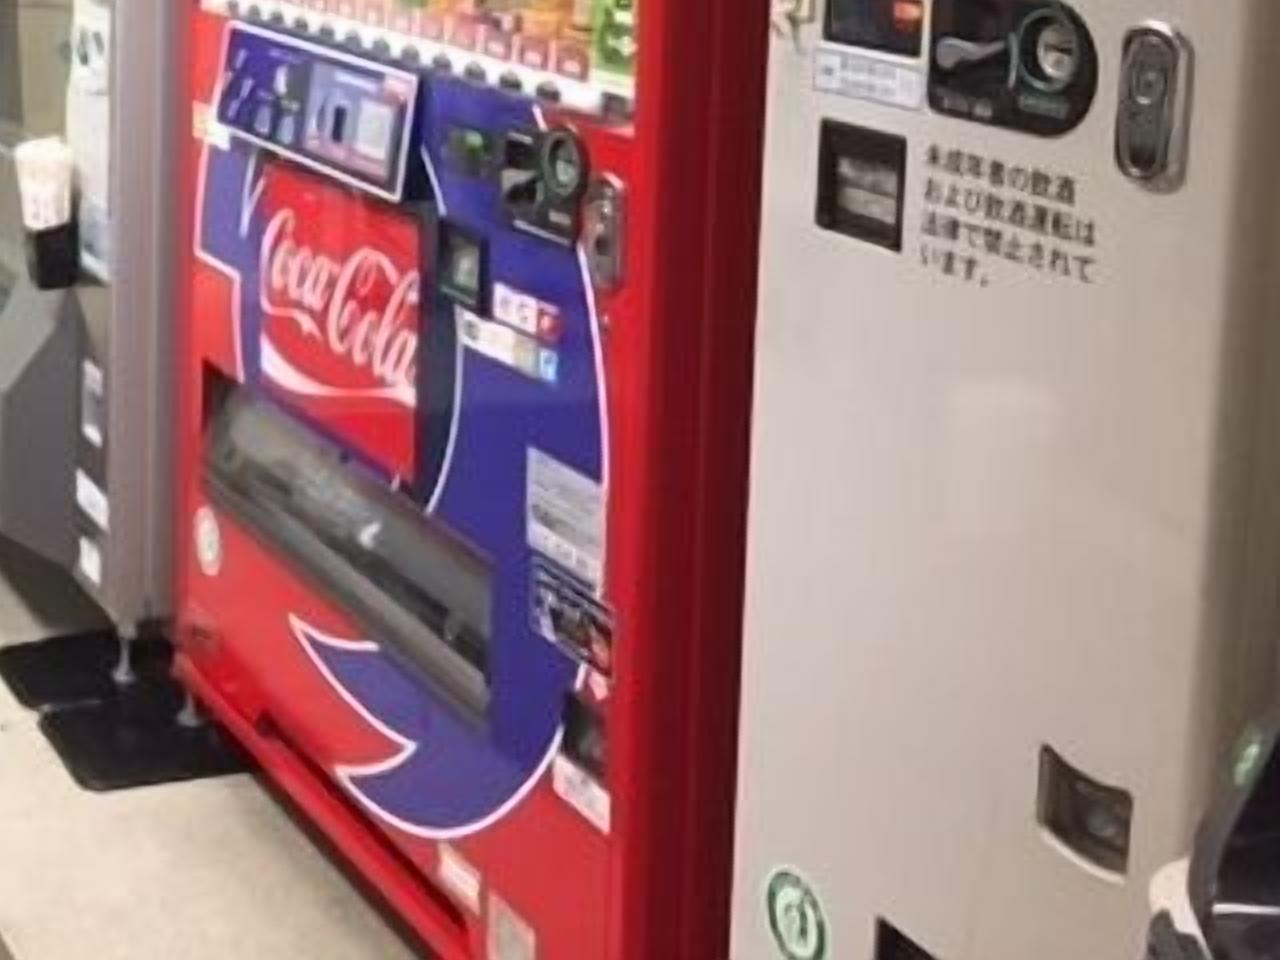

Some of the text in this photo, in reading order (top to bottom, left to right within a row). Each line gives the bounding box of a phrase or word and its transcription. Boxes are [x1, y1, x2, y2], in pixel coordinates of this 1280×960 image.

[926, 143, 1076, 208] 未成年者の飲酒
